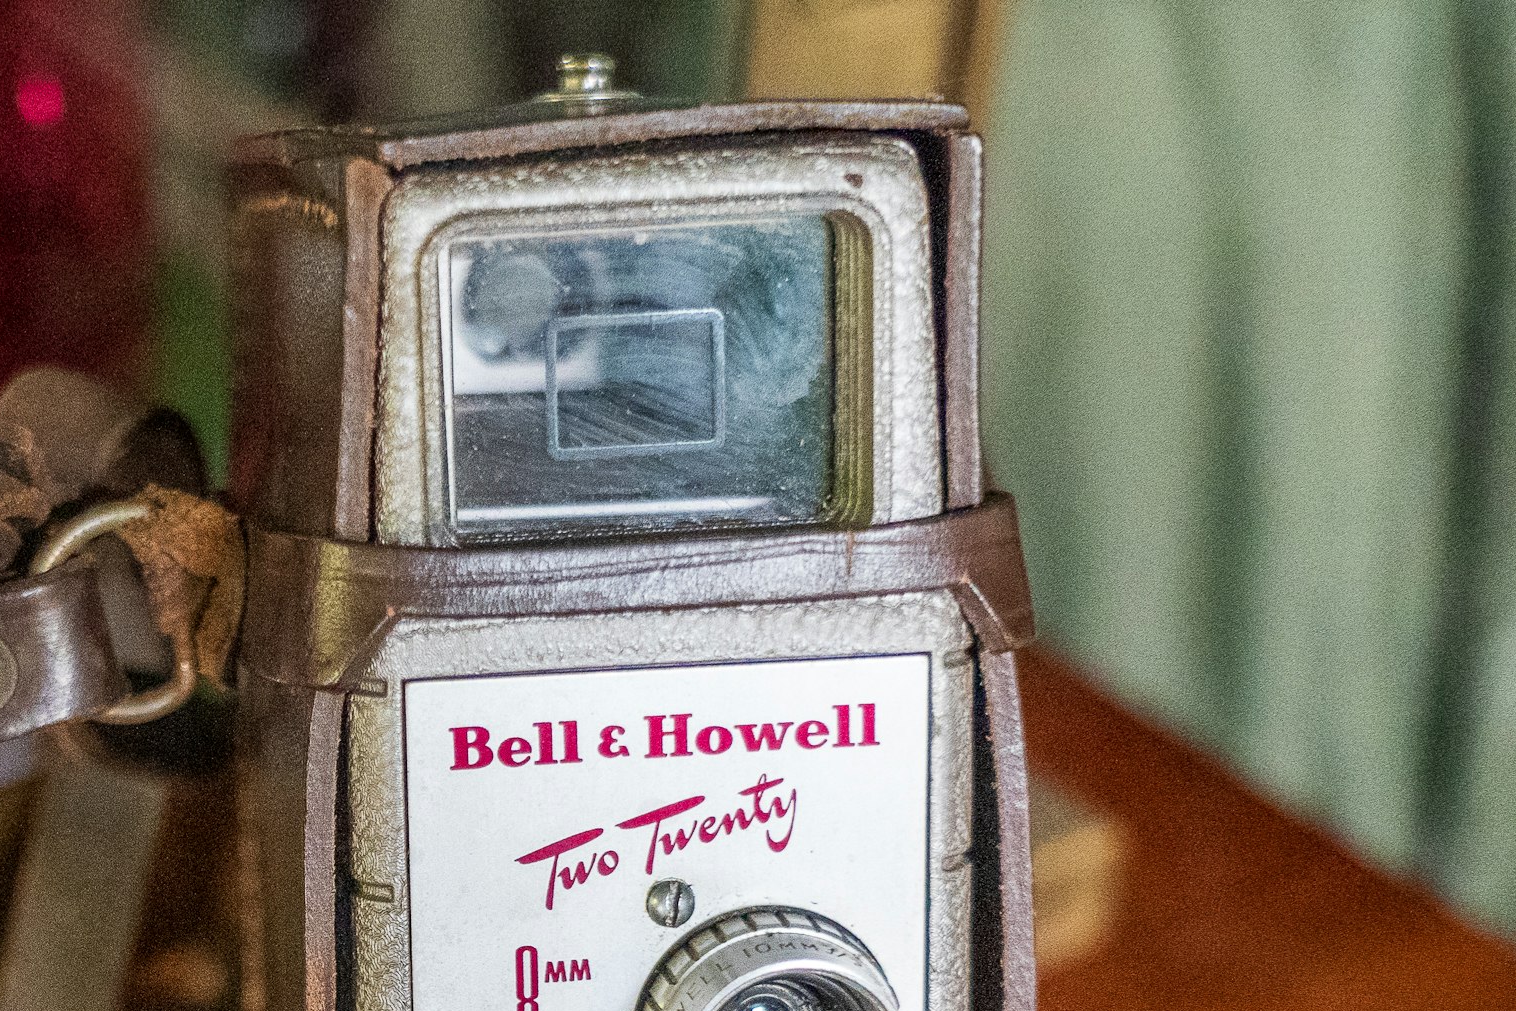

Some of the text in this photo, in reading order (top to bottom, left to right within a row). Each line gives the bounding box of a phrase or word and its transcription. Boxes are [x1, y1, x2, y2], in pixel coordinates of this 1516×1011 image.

[449, 702, 879, 771] Bell & Howell
[514, 773, 797, 910] Two Twenty
